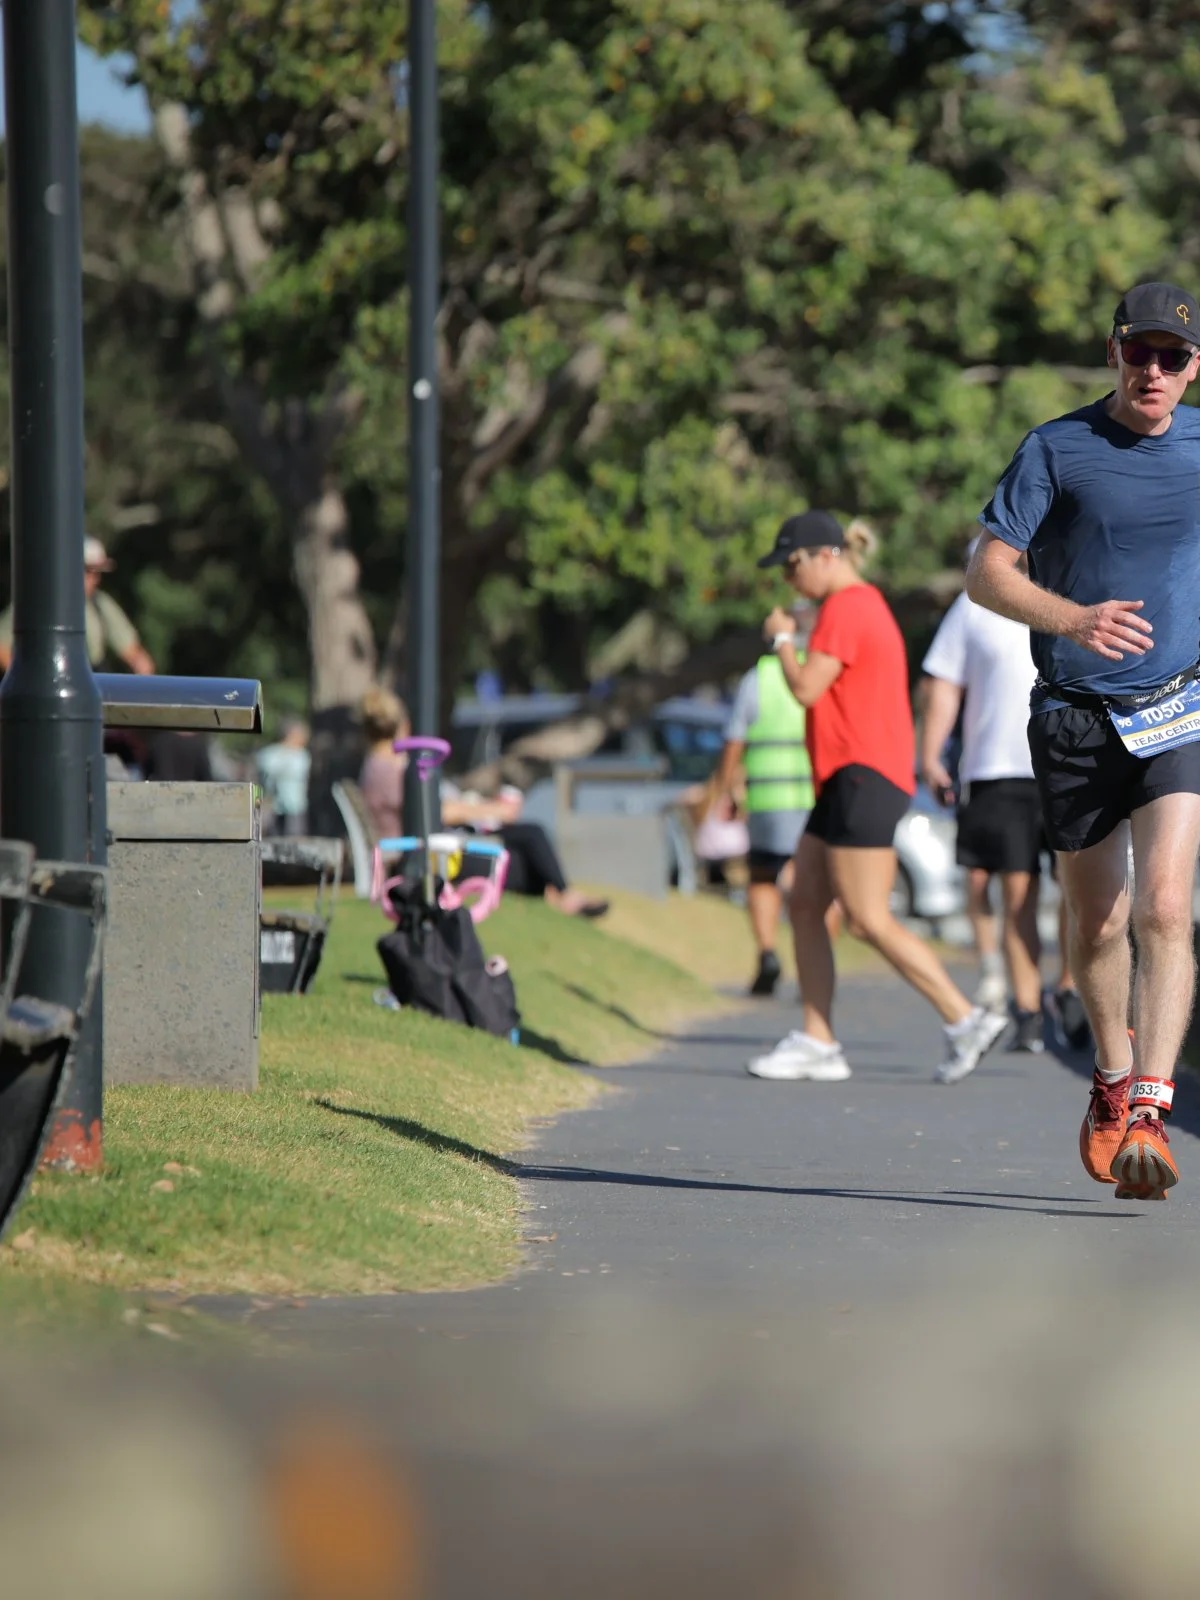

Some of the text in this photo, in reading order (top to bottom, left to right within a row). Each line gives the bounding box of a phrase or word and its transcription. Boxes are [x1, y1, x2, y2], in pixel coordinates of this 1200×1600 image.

[1141, 698, 1185, 725] 1050
[1132, 732, 1164, 747] TEAM
[1134, 1084, 1161, 1097] 0532
